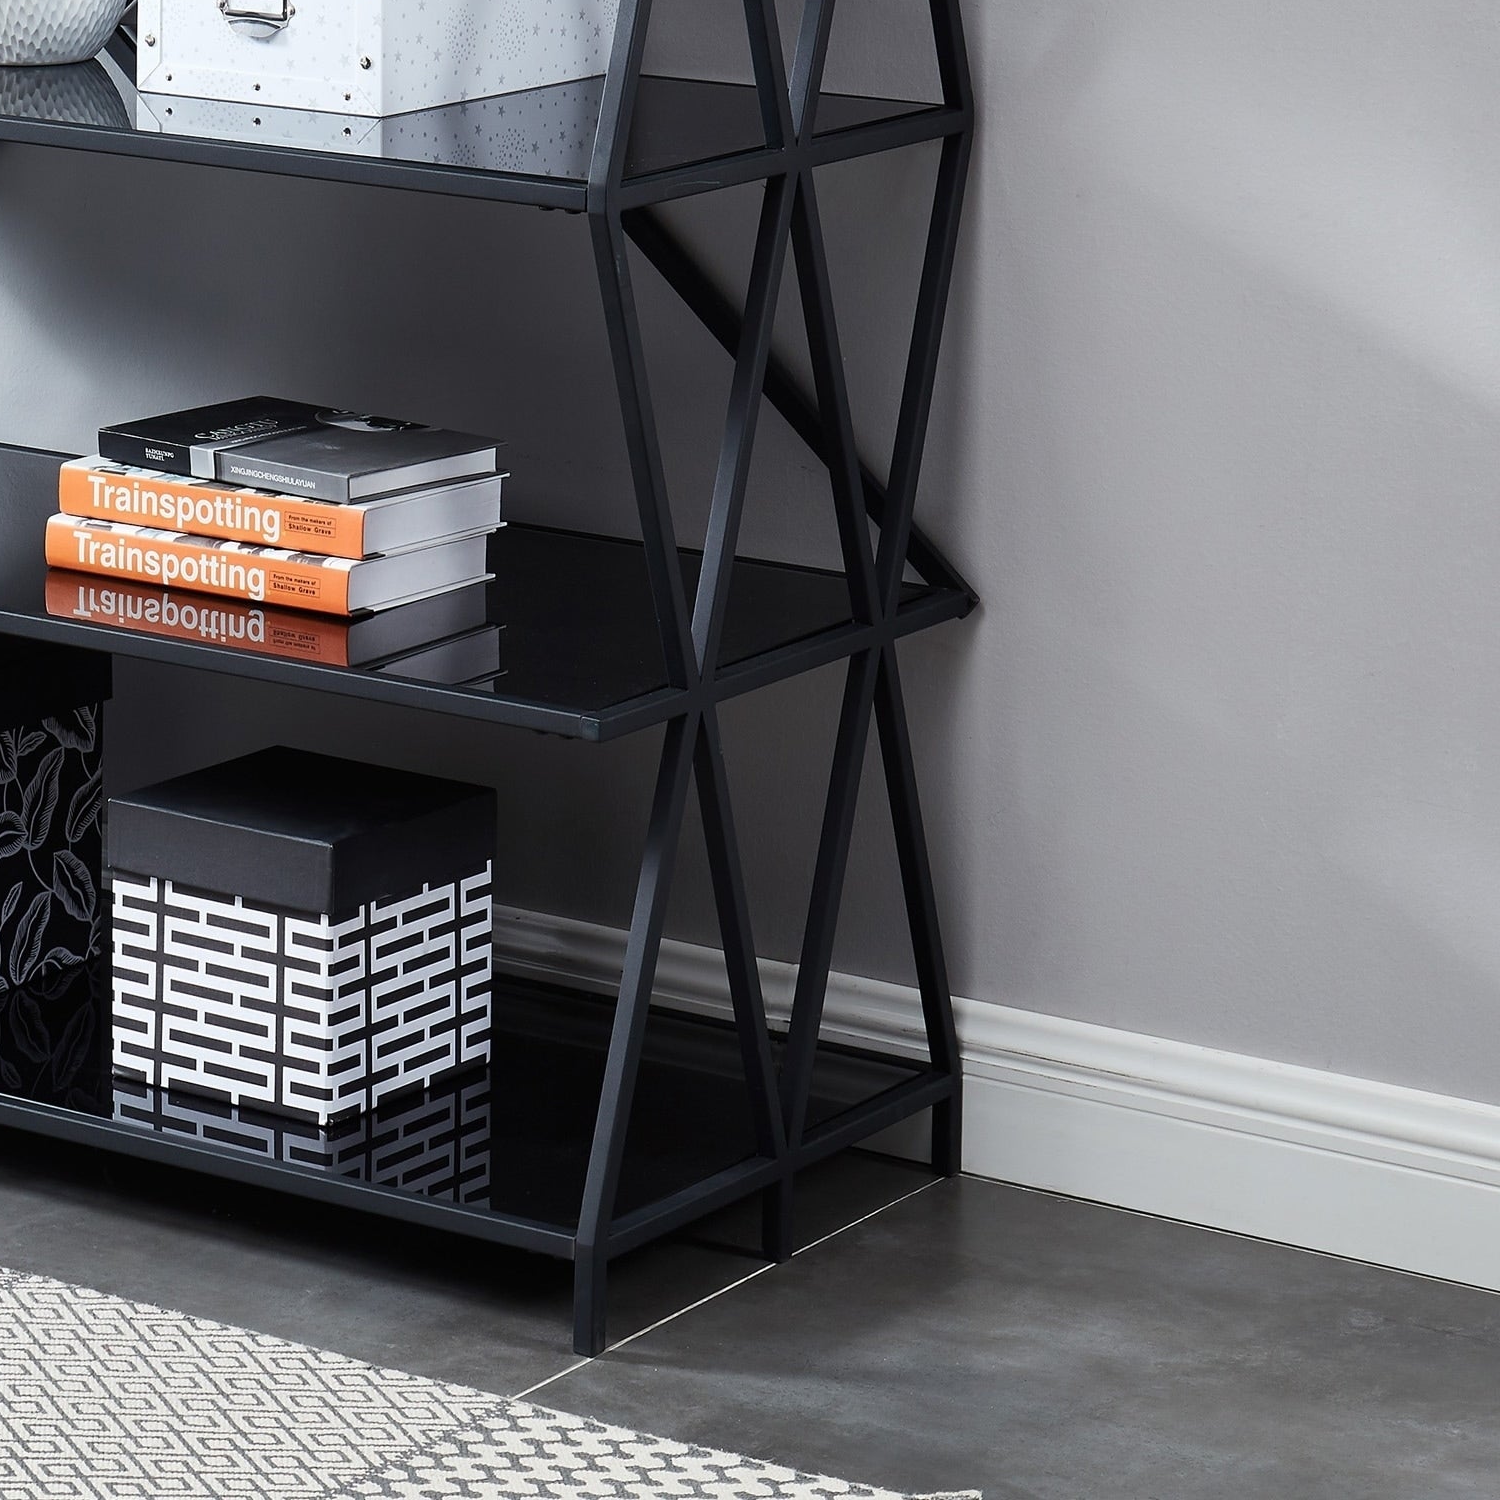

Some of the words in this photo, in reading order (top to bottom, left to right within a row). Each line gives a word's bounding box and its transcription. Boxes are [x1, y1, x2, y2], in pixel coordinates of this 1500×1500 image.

[87, 475, 281, 544] Trainspotting
[288, 523, 311, 532] Shallow
[314, 526, 332, 535] Grave
[73, 530, 266, 601] Trainspotting
[294, 577, 310, 585] makers
[273, 582, 296, 592] Shallow
[298, 586, 316, 595] Grave
